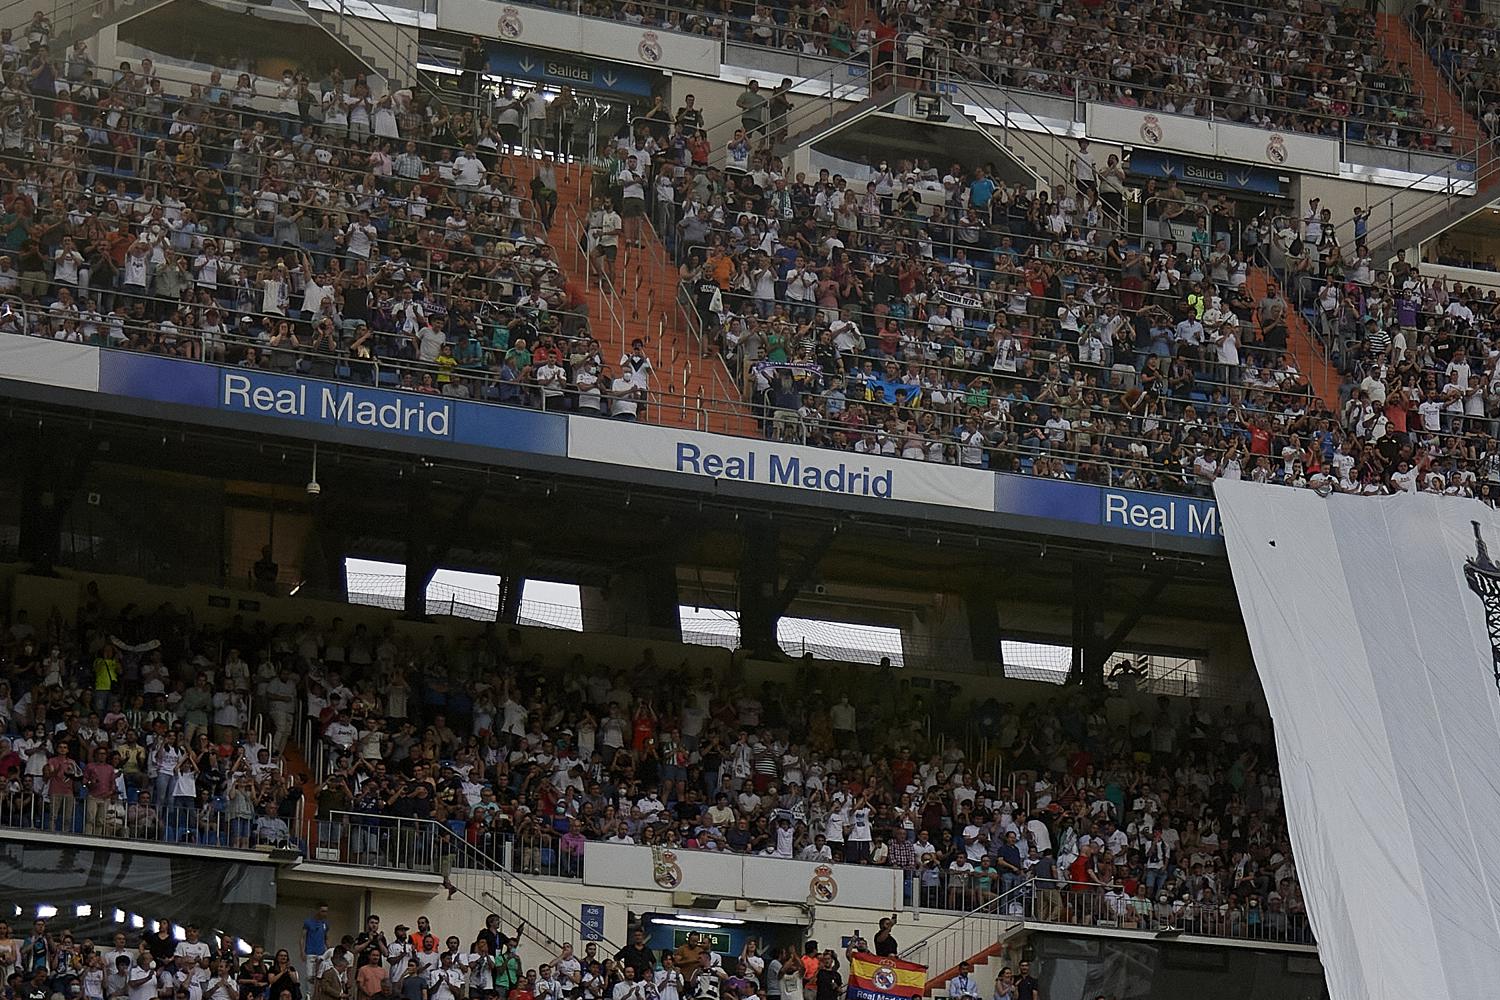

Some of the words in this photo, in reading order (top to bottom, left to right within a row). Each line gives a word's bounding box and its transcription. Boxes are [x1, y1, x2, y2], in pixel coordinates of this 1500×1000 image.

[547, 63, 589, 81] Salida
[1186, 165, 1224, 181] Salida
[223, 373, 306, 416] Real
[320, 387, 449, 436] Madrid
[676, 442, 755, 480] Real
[769, 454, 893, 498] Madrid
[1106, 493, 1175, 530] Real
[856, 990, 875, 1000] Real
